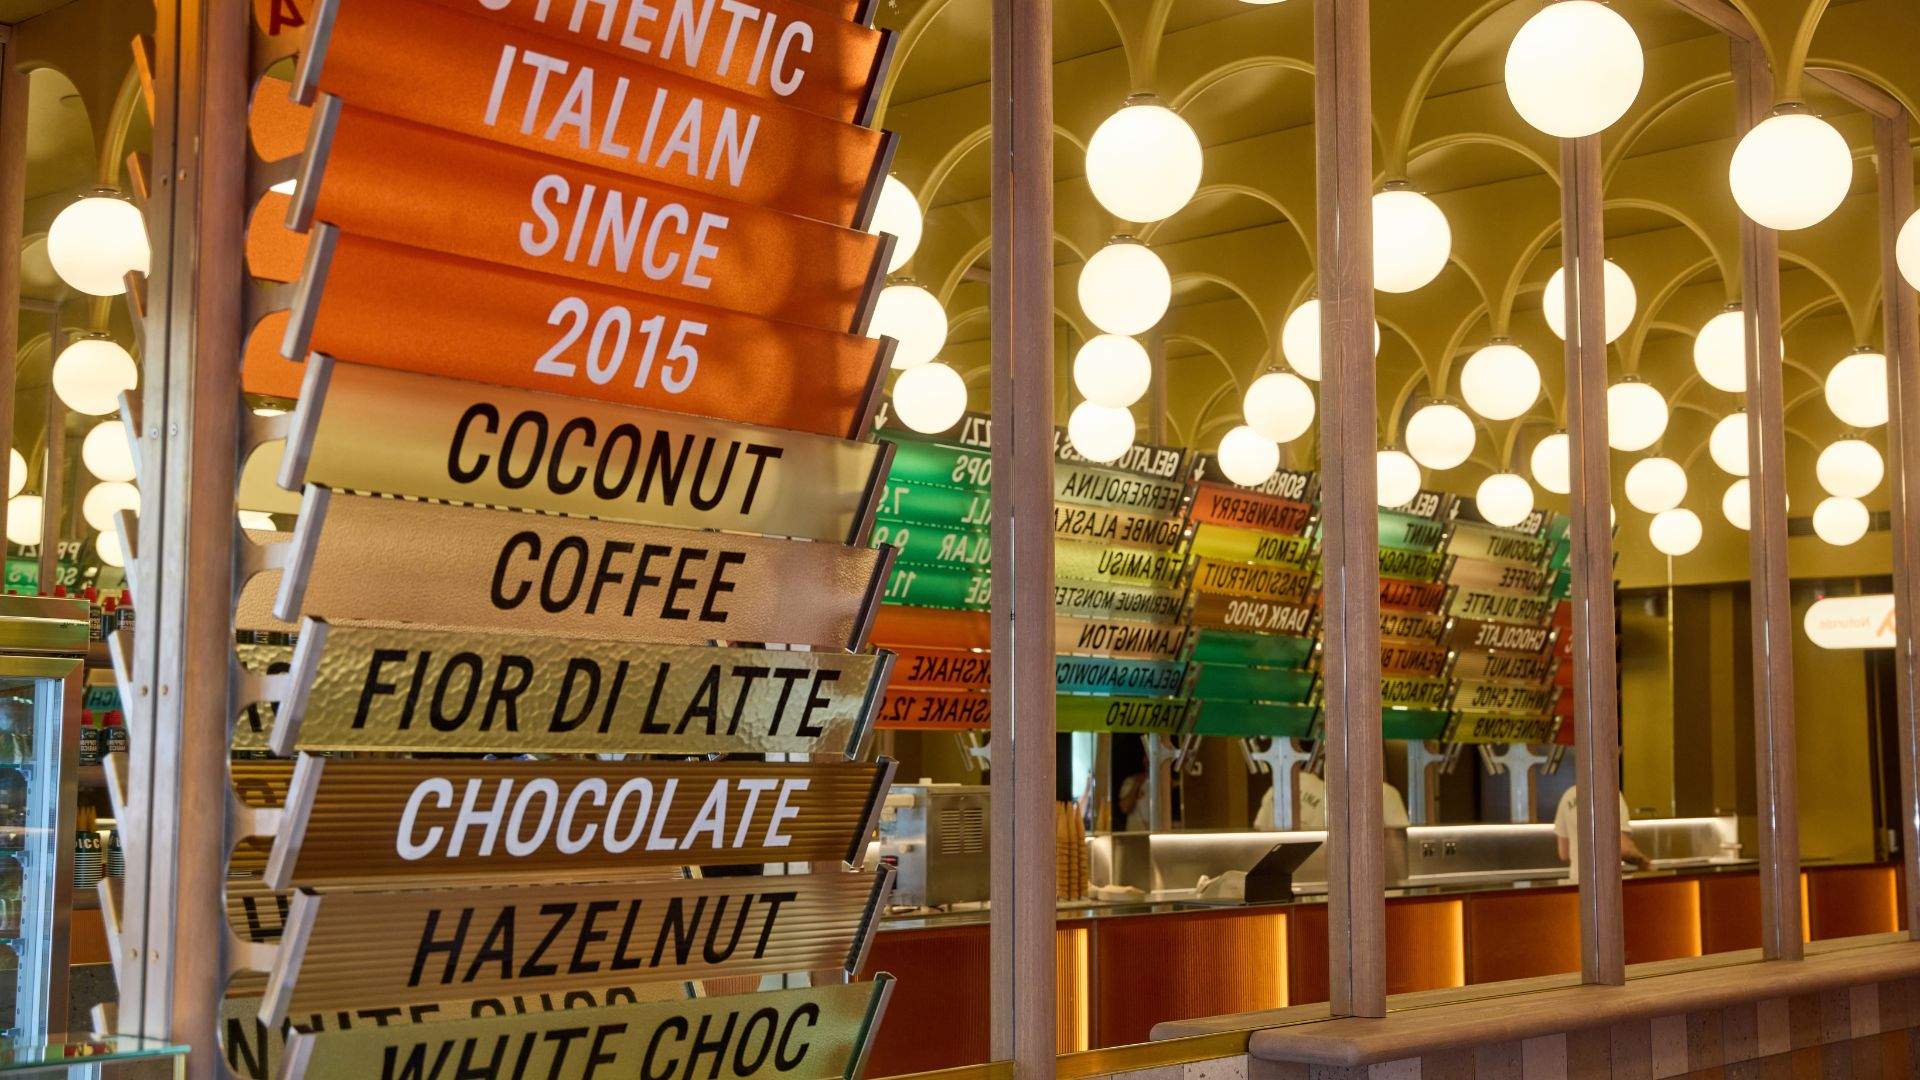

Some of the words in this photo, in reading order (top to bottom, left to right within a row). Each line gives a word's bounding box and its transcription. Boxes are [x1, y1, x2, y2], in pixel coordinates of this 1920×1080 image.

[483, 44, 761, 188] ITALIAN
[519, 174, 730, 290] SINCE
[533, 297, 708, 394] 2015
[447, 403, 784, 515] COCONUT
[490, 531, 747, 623] COFFEE
[351, 649, 535, 732] FIOR
[548, 660, 628, 734] DI
[639, 663, 842, 738] LATTE
[396, 777, 811, 861] CHOCOLATE
[407, 891, 797, 988] HAZELNUT
[640, 1002, 820, 1080] CHOC
